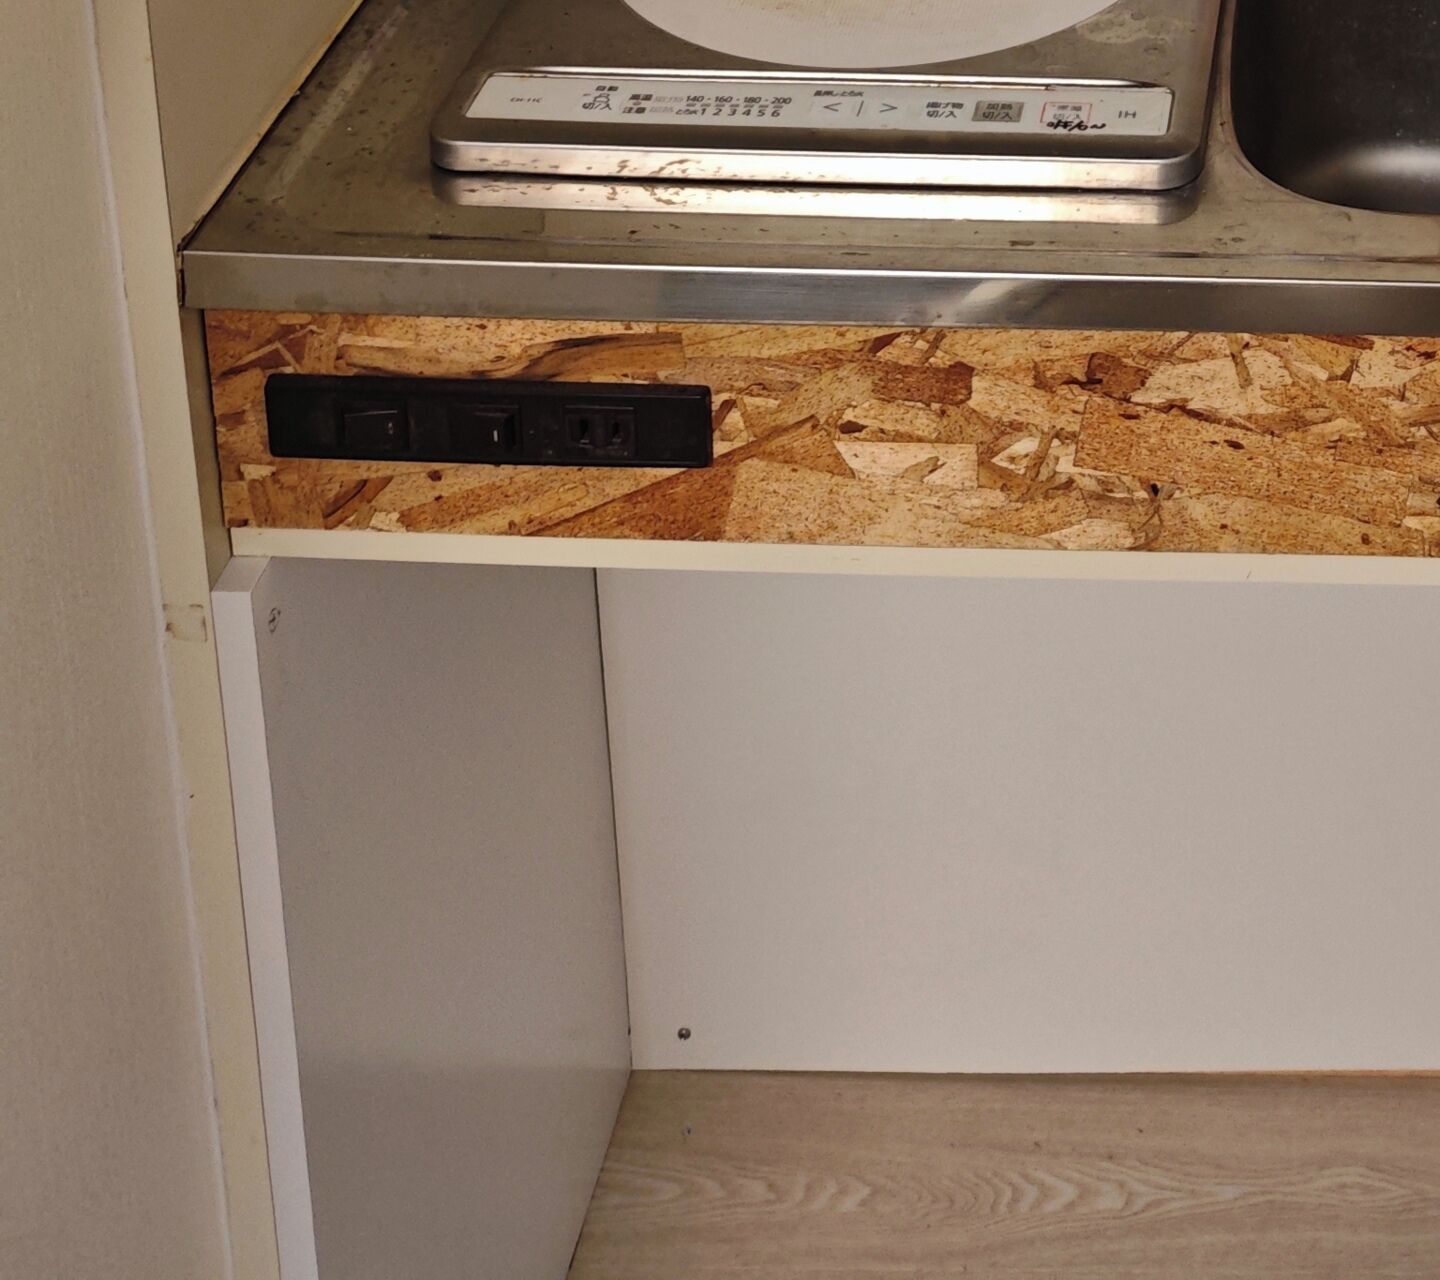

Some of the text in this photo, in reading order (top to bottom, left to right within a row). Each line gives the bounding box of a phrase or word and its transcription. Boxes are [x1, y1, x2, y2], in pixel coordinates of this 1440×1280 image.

[712, 108, 722, 116] 2
[727, 108, 738, 116] 3
[742, 109, 751, 117] 4
[757, 109, 766, 117] 5
[771, 109, 781, 118] 6
[926, 110, 957, 118] 切/入
[982, 111, 1012, 120] 切/入
